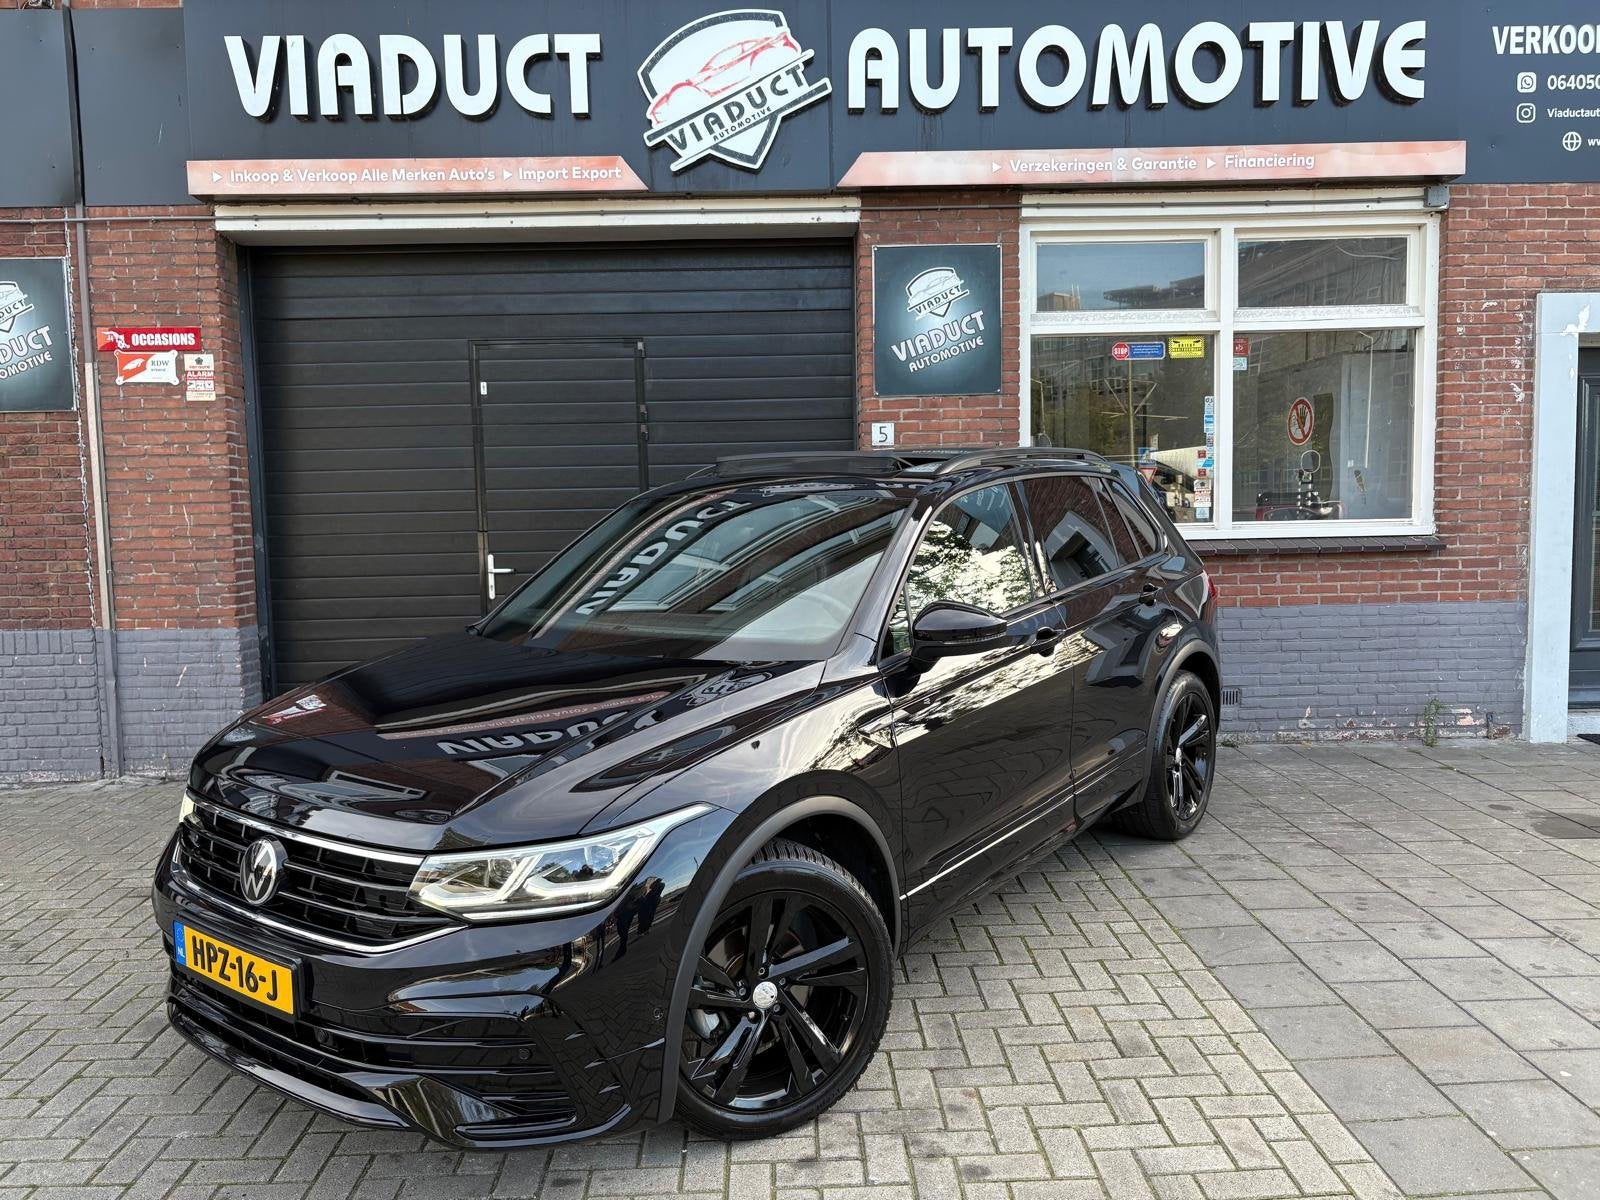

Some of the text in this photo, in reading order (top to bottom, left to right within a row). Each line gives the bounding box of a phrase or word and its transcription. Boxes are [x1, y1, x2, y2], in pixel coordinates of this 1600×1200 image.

[1491, 24, 1600, 55] VERKOO
[224, 33, 602, 117] VIADUCT
[847, 20, 1426, 109] AUTOMOTIVE
[667, 64, 804, 150] VIADUCT
[713, 106, 772, 141] AUTOMOTIVE
[230, 166, 622, 184] Inkoop & Verkoop Alle Merken Auto's Import Export
[1009, 154, 1315, 173] Verzekeringen & Garantie Financiering
[915, 285, 961, 314] VIADUCT
[131, 333, 196, 346] OCCASIONS
[891, 310, 985, 362] VIADUCT
[908, 336, 984, 373] AUTOMOTIVE
[187, 371, 214, 379] ALARM
[878, 426, 888, 442] 5
[191, 935, 278, 1001] HPZ-16-J
